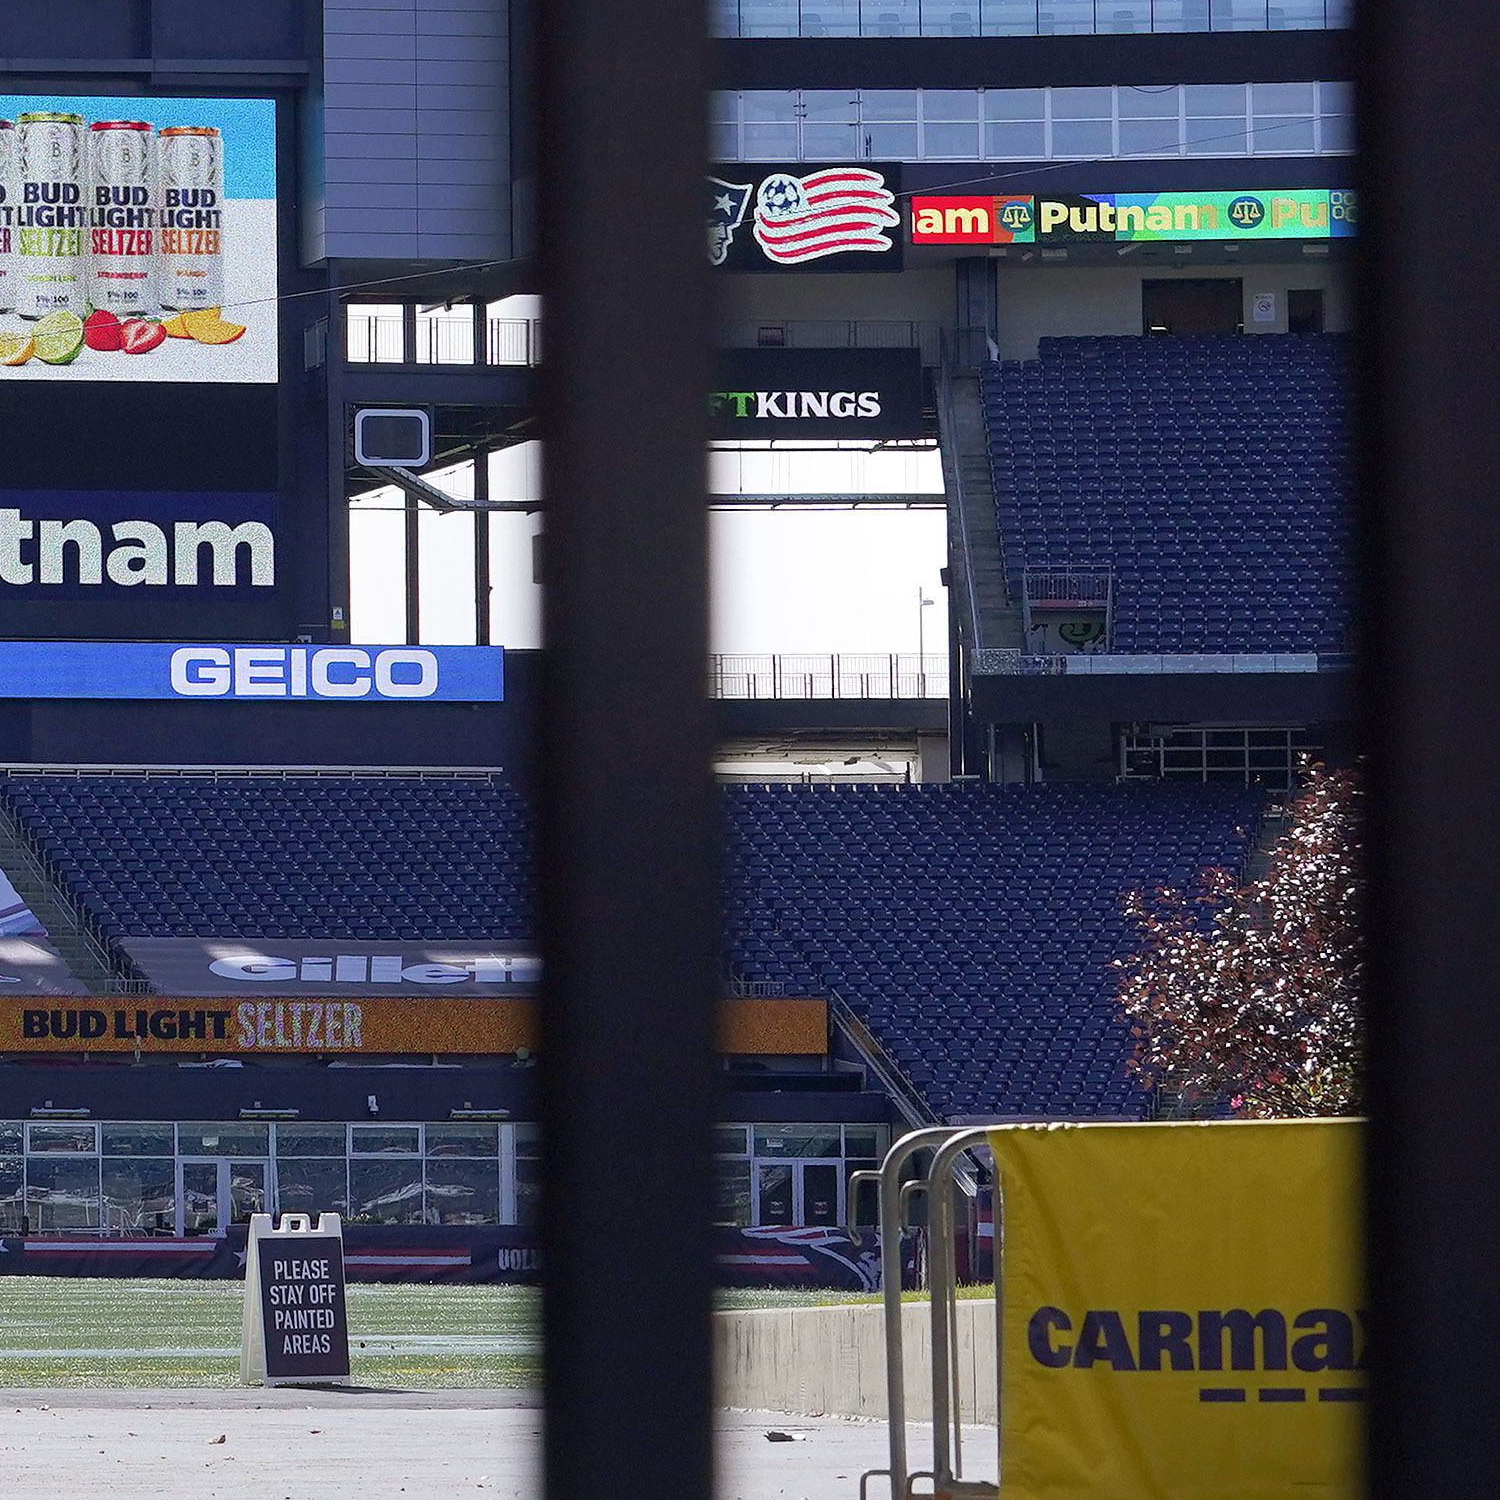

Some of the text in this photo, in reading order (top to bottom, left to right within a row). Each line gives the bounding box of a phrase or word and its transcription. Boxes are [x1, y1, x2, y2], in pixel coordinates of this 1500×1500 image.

[23, 183, 80, 204] BUD
[96, 186, 149, 206] BUD
[166, 189, 216, 208] BUD
[18, 205, 86, 227] LIGHT
[90, 208, 155, 228] LIGHT
[160, 209, 221, 228] LIGHT
[1041, 200, 1217, 233] Putnam
[92, 229, 153, 255] SELTZER
[161, 229, 220, 255] SELTZER
[170, 647, 438, 698] GEICO
[208, 955, 541, 984] Gillett
[23, 1002, 363, 1048] BUD LIGHT SELTZER
[274, 1259, 329, 1280] PLEASE
[270, 1284, 336, 1305] STAY OFF
[275, 1309, 335, 1329] PAINTED
[283, 1334, 331, 1354] AREAS
